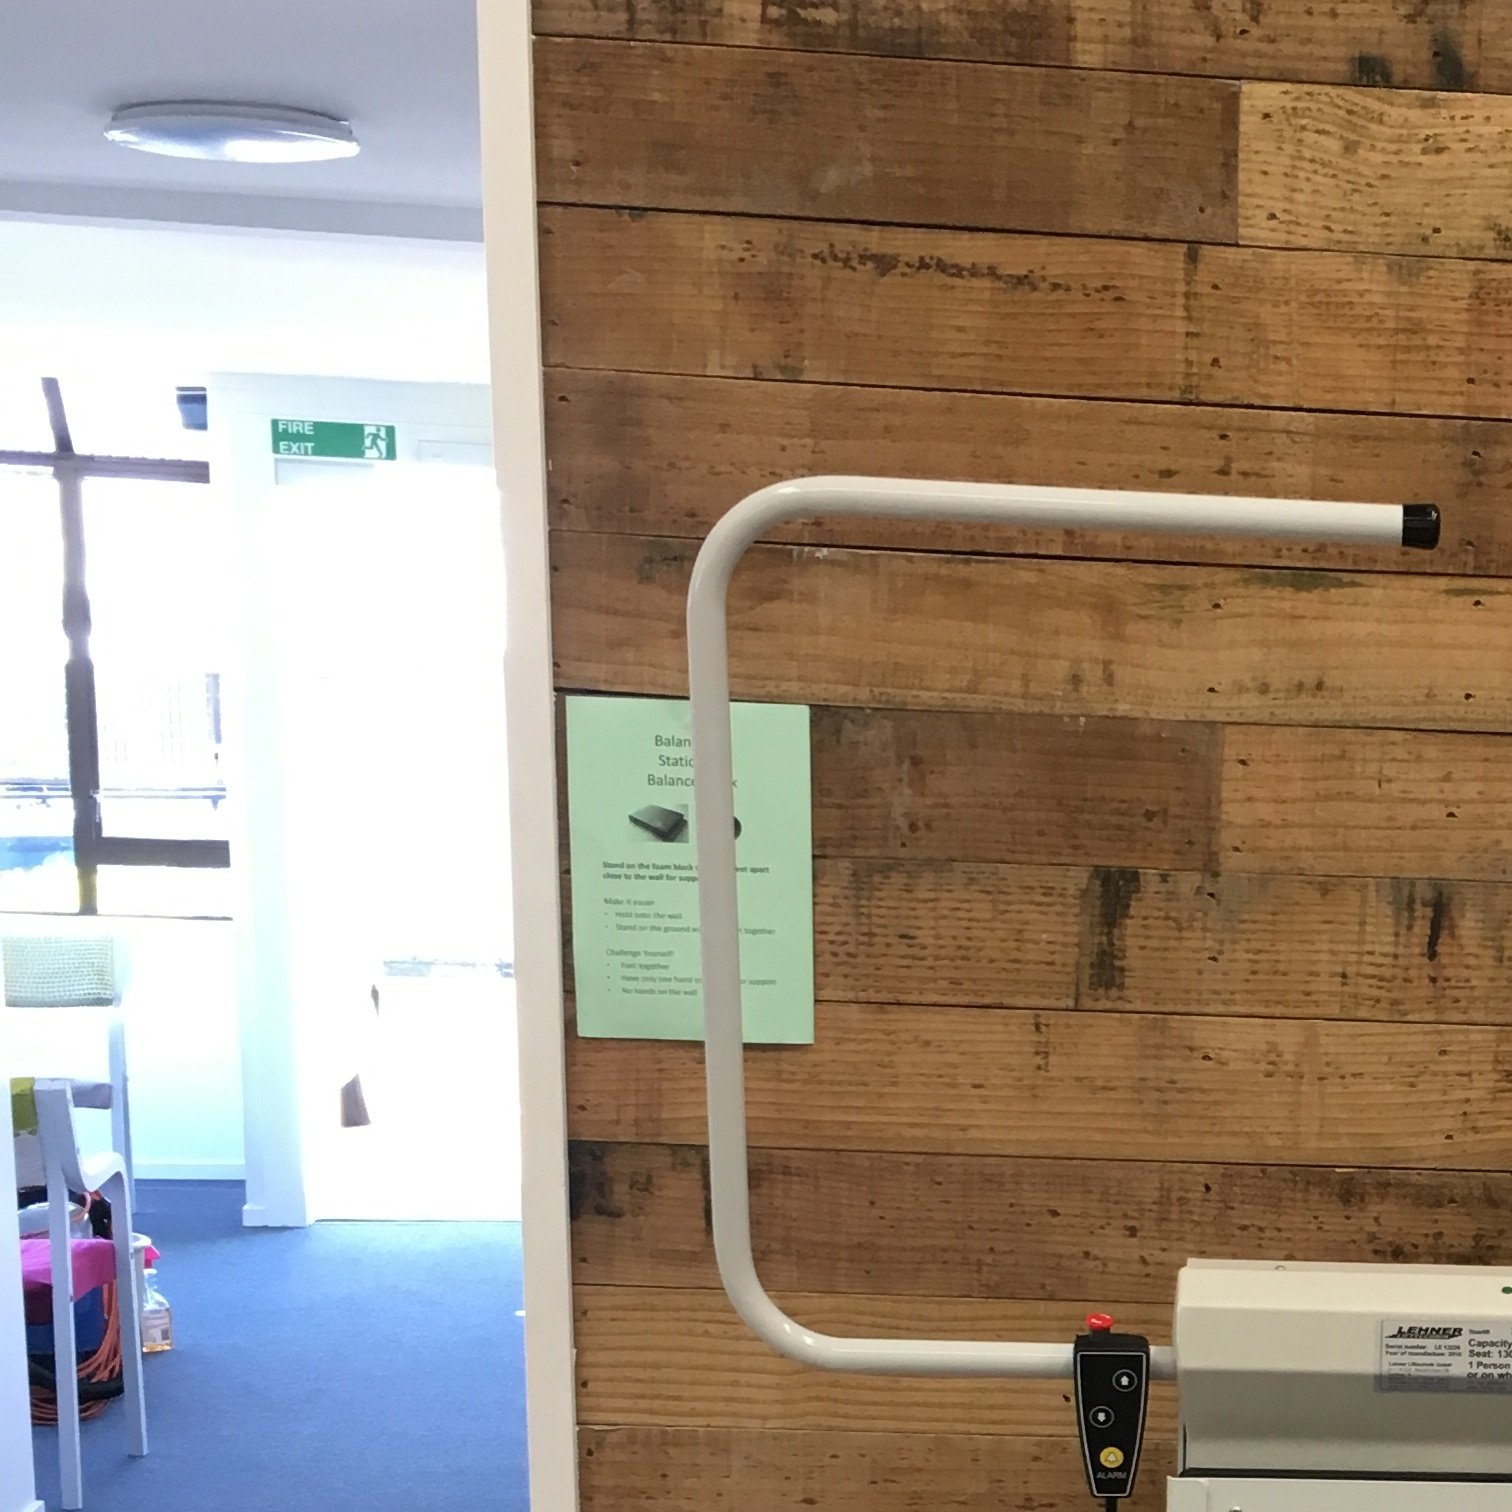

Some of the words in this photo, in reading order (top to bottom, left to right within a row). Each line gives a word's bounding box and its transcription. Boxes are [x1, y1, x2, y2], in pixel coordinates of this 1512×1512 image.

[278, 420, 314, 435] FIRE
[279, 442, 315, 455] EXIT
[655, 734, 692, 747] Balan
[1392, 1326, 1463, 1338] LEHNER
[1468, 1349, 1493, 1358] Seat:
[1476, 1361, 1511, 1370] Person
[1480, 1372, 1495, 1380] on
[1095, 1471, 1127, 1480] ALARM
